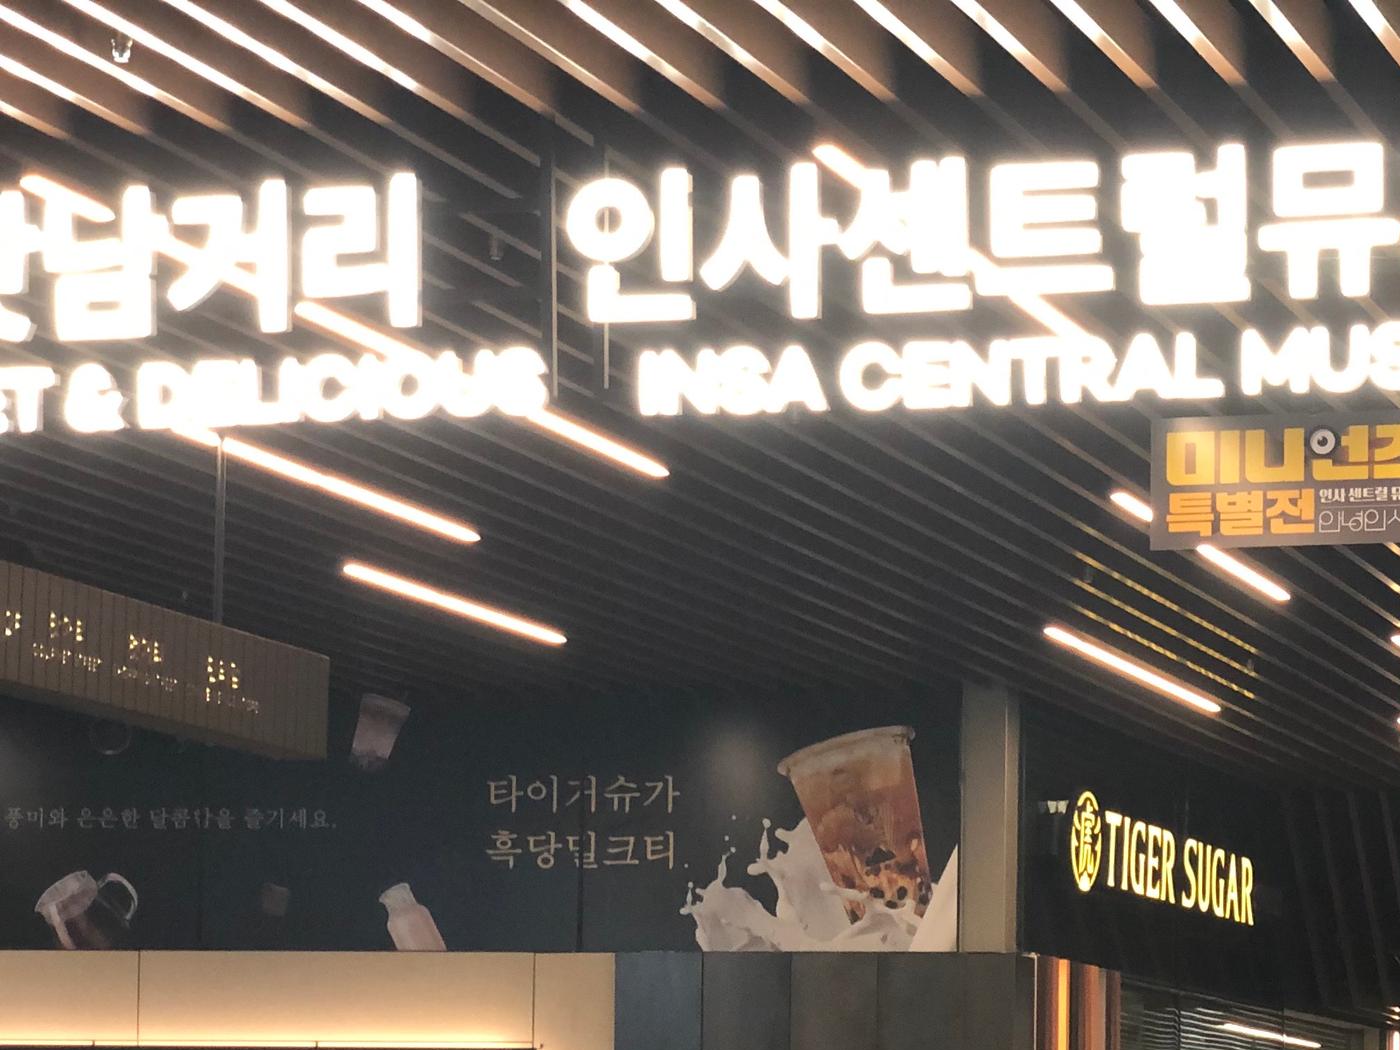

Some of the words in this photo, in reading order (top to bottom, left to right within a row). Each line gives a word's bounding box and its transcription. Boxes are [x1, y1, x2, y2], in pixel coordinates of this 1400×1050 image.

[0, 365, 60, 433] T
[63, 362, 128, 433] &
[135, 345, 549, 431] DELICIOUS
[637, 344, 826, 417] INSA
[839, 329, 1225, 411] CENTRAL
[1166, 488, 1316, 537] 특별전
[1319, 488, 1346, 503] 인사
[1348, 486, 1388, 502] 센트럴
[486, 774, 681, 813] 타이거슈가
[1104, 810, 1176, 904] TIGER
[1181, 838, 1255, 926] SUGAR
